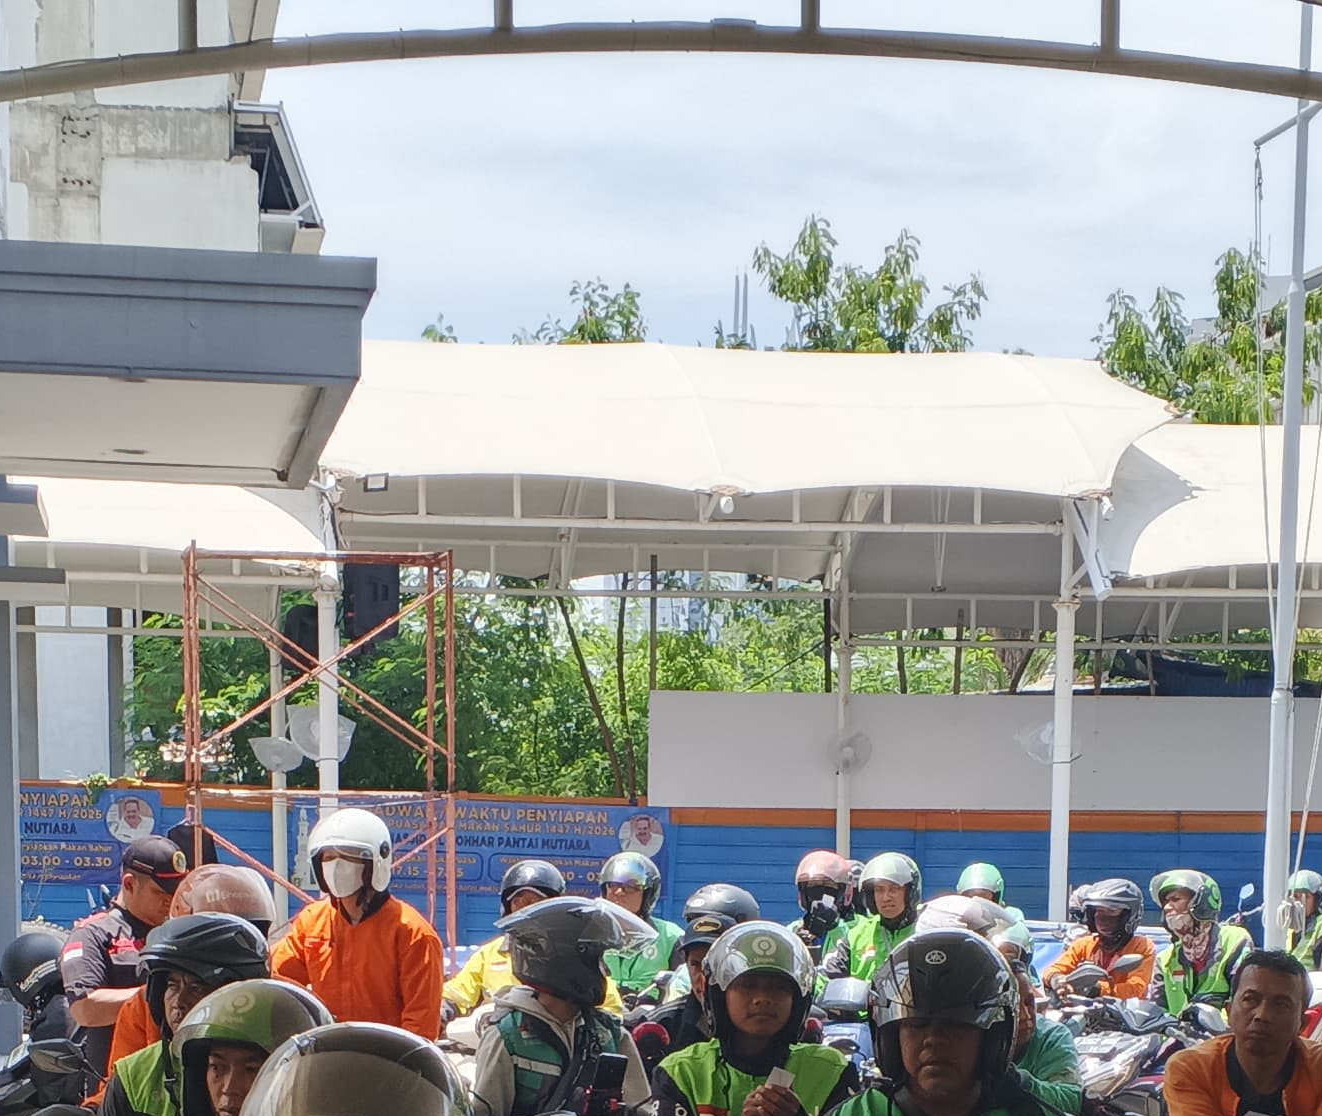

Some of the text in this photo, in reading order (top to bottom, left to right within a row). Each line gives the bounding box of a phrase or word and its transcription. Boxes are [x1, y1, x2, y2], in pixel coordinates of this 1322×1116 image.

[455, 807, 511, 820] WAKTU
[516, 808, 609, 824] PENYIAPAN
[460, 822, 500, 832] MAKAN
[503, 823, 542, 834] SAHUR
[21, 855, 61, 866] 03.00
[73, 856, 113, 867] 03.30
